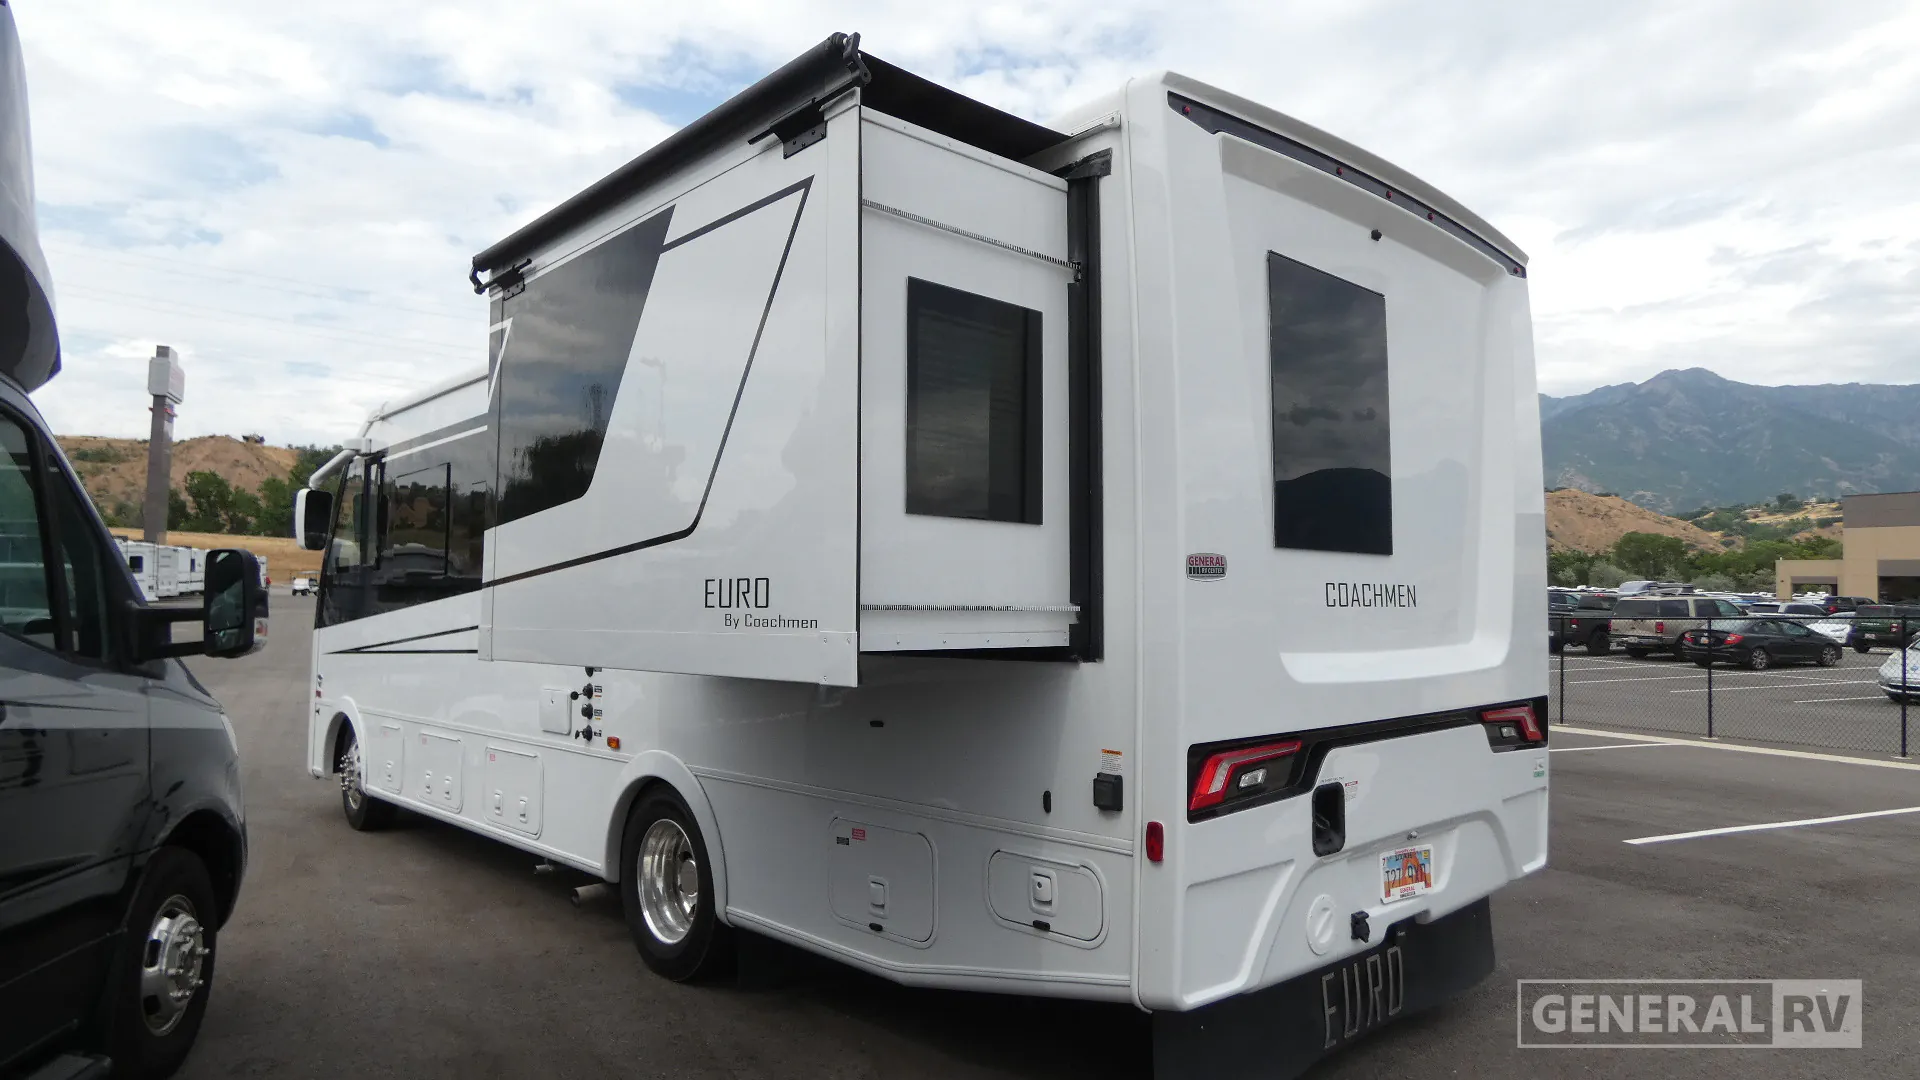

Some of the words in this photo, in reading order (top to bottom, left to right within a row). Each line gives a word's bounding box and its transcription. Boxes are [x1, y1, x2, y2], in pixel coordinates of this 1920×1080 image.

[1188, 556, 1225, 567] GENERAL
[704, 578, 769, 608] EURO
[1325, 582, 1417, 607] COACHMEN
[725, 613, 740, 629] By
[744, 613, 818, 629] Coachmen
[1322, 946, 1404, 1048] EURO
